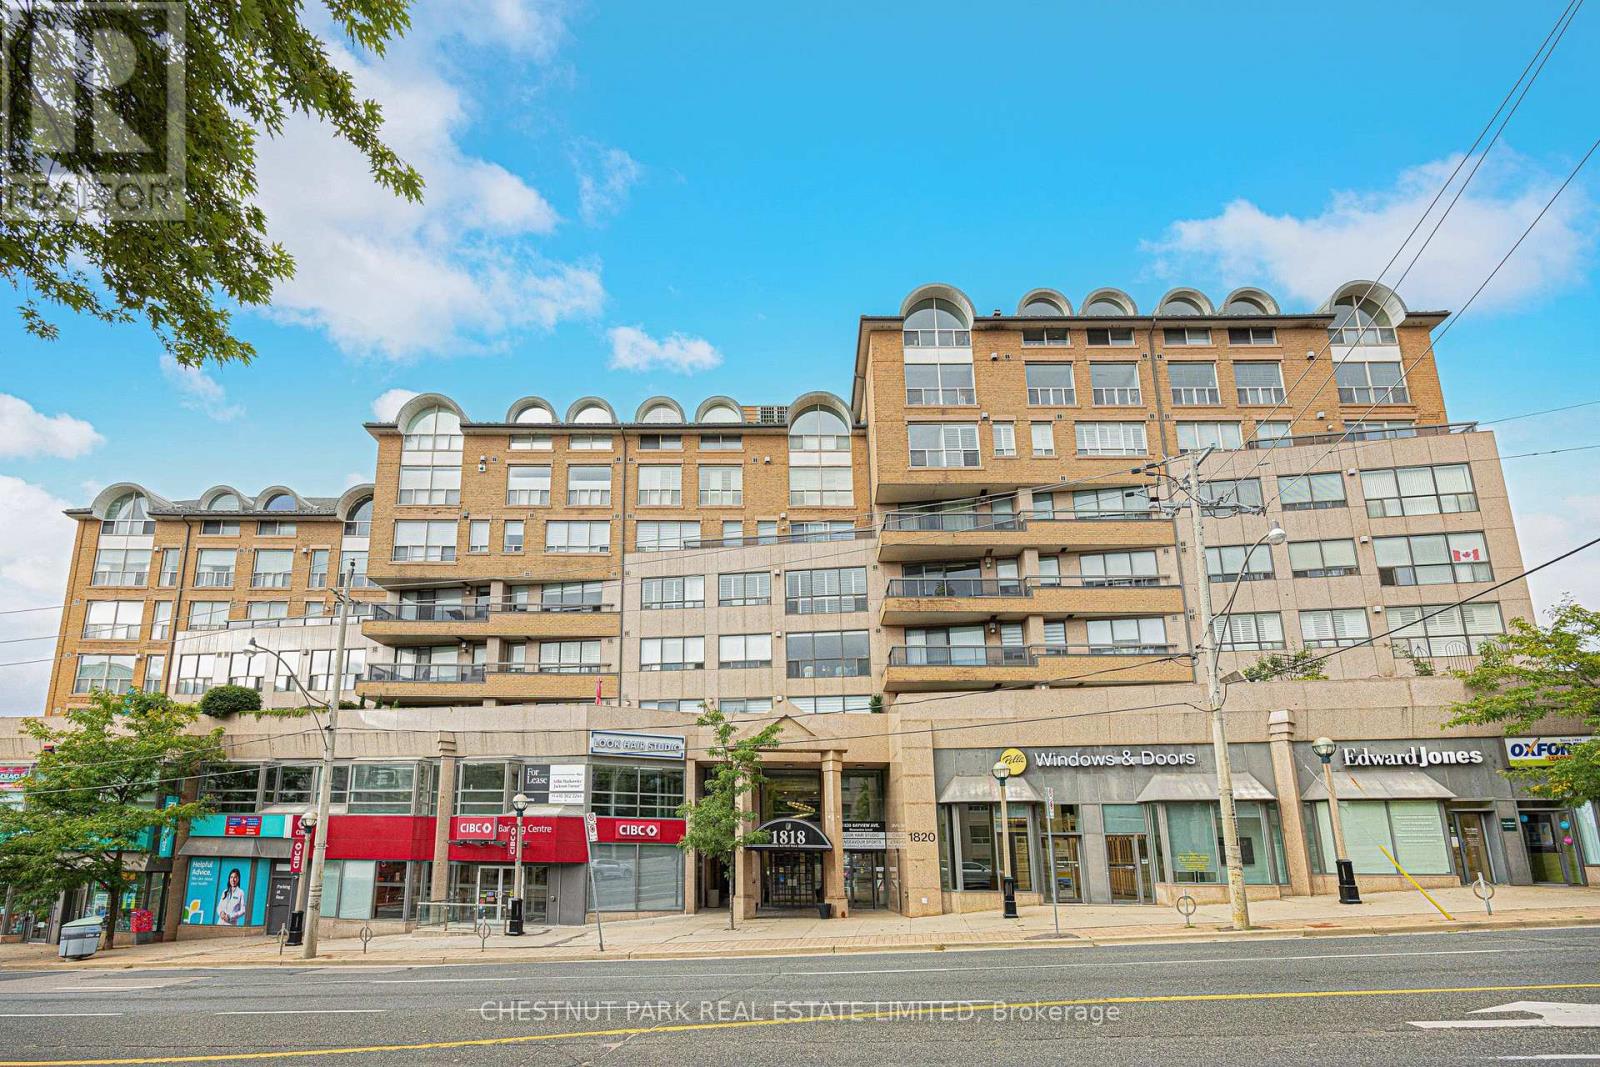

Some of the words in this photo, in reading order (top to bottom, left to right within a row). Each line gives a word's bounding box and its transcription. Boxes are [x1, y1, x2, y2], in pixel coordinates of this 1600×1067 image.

[593, 738, 621, 749] LOOK
[623, 740, 646, 750] HAIR
[648, 742, 682, 752] STUDIO
[1510, 741, 1579, 757] OXFOR
[1035, 752, 1115, 767] Windows
[1122, 750, 1136, 766] &
[1141, 751, 1196, 766] Doors
[1343, 746, 1419, 766] Edward
[1419, 746, 1483, 768] Jones
[527, 767, 540, 776] For
[527, 775, 548, 785] Lease
[460, 823, 482, 833] CIBC
[527, 824, 552, 833] Centre
[619, 824, 646, 836] CIBC
[772, 830, 806, 844] 1818
[908, 832, 936, 842] 1820
[293, 850, 301, 869] CIBC
